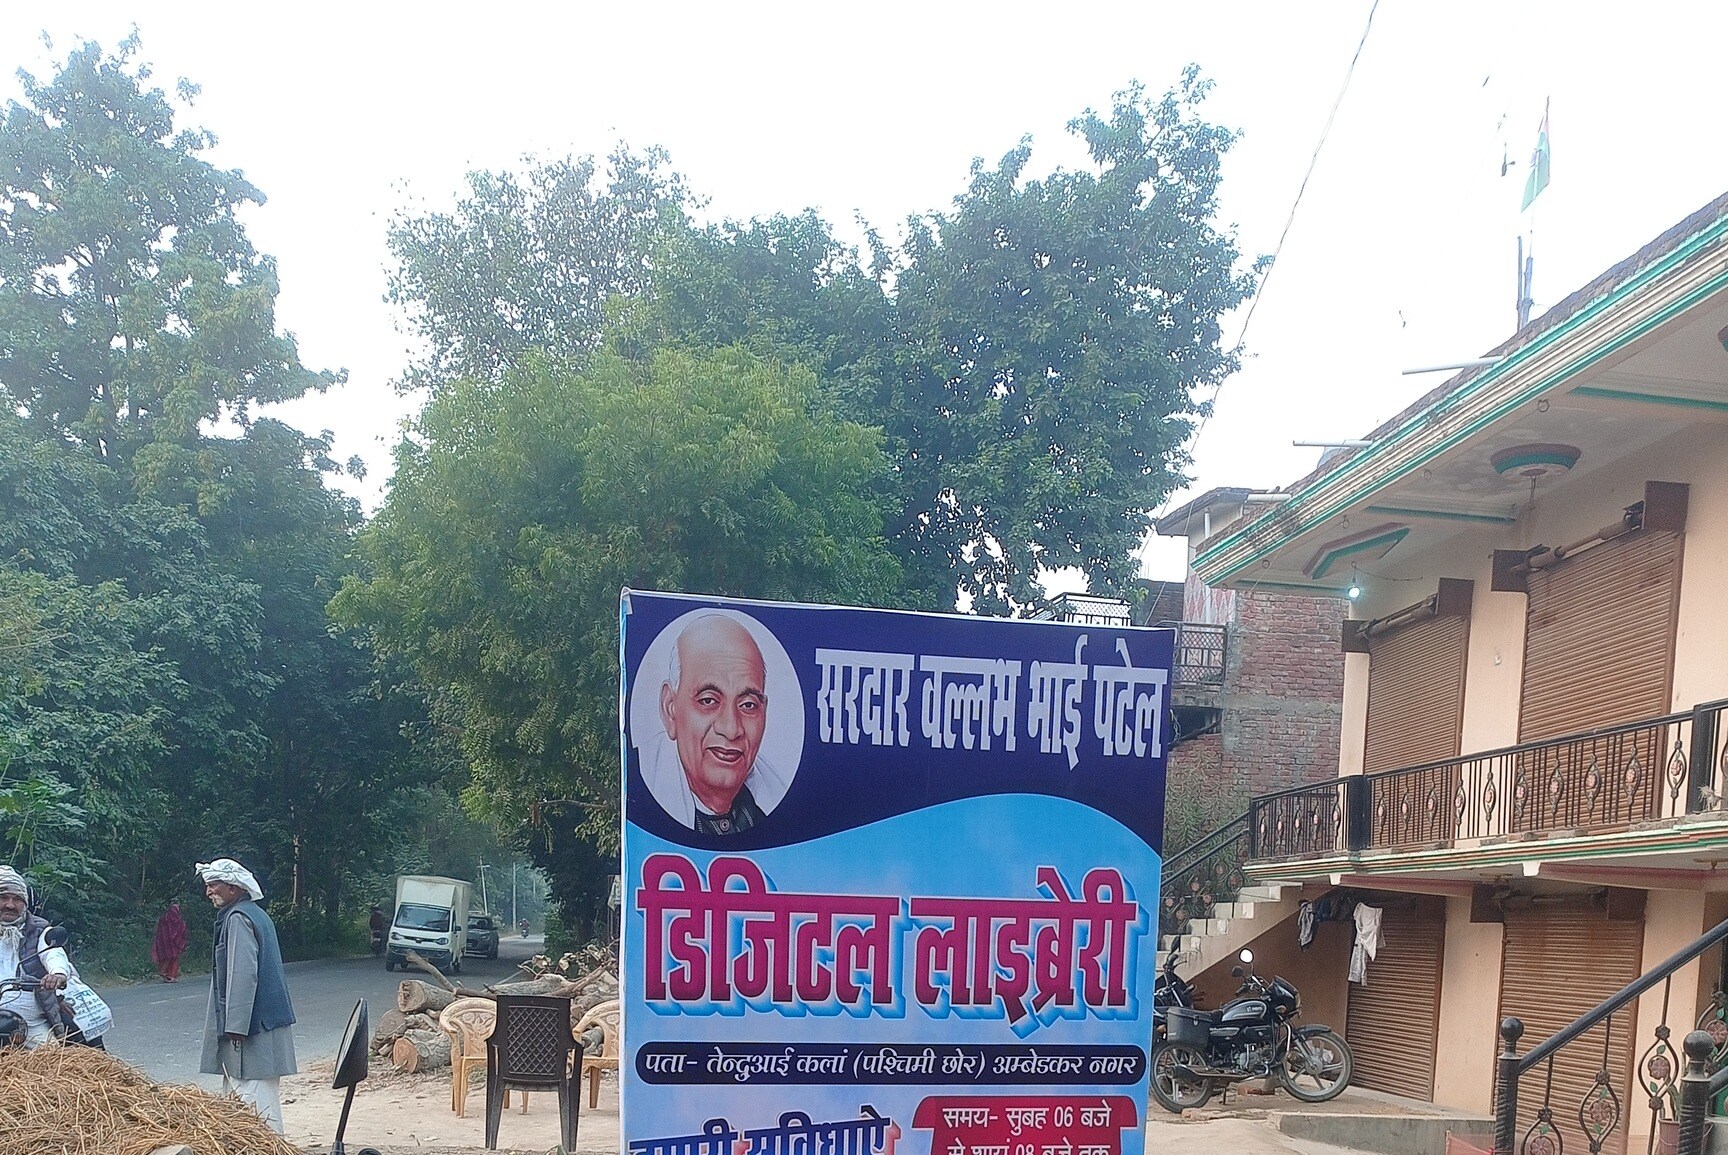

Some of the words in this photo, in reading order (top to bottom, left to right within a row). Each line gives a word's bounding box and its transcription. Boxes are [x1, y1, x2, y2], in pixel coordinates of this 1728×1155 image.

[816, 647, 915, 748] सरदार
[919, 654, 1022, 752] वल्लभ
[1027, 634, 1089, 771] भाई
[1092, 637, 1169, 759] पटेल
[636, 852, 900, 1004] डिजिटल
[909, 866, 1137, 1025] लाइब्रेरी
[706, 1046, 795, 1082] तेन्दुआई
[796, 1048, 848, 1074] कलां
[853, 1047, 937, 1079] (पश्चिमी
[941, 1047, 986, 1079] छोर)
[992, 1048, 1084, 1075] अम्बेडकर
[1089, 1056, 1138, 1075] नगर
[1005, 1107, 1049, 1136] सुबह
[1054, 1106, 1073, 1128] 06
[1080, 1099, 1112, 1128] बजे
